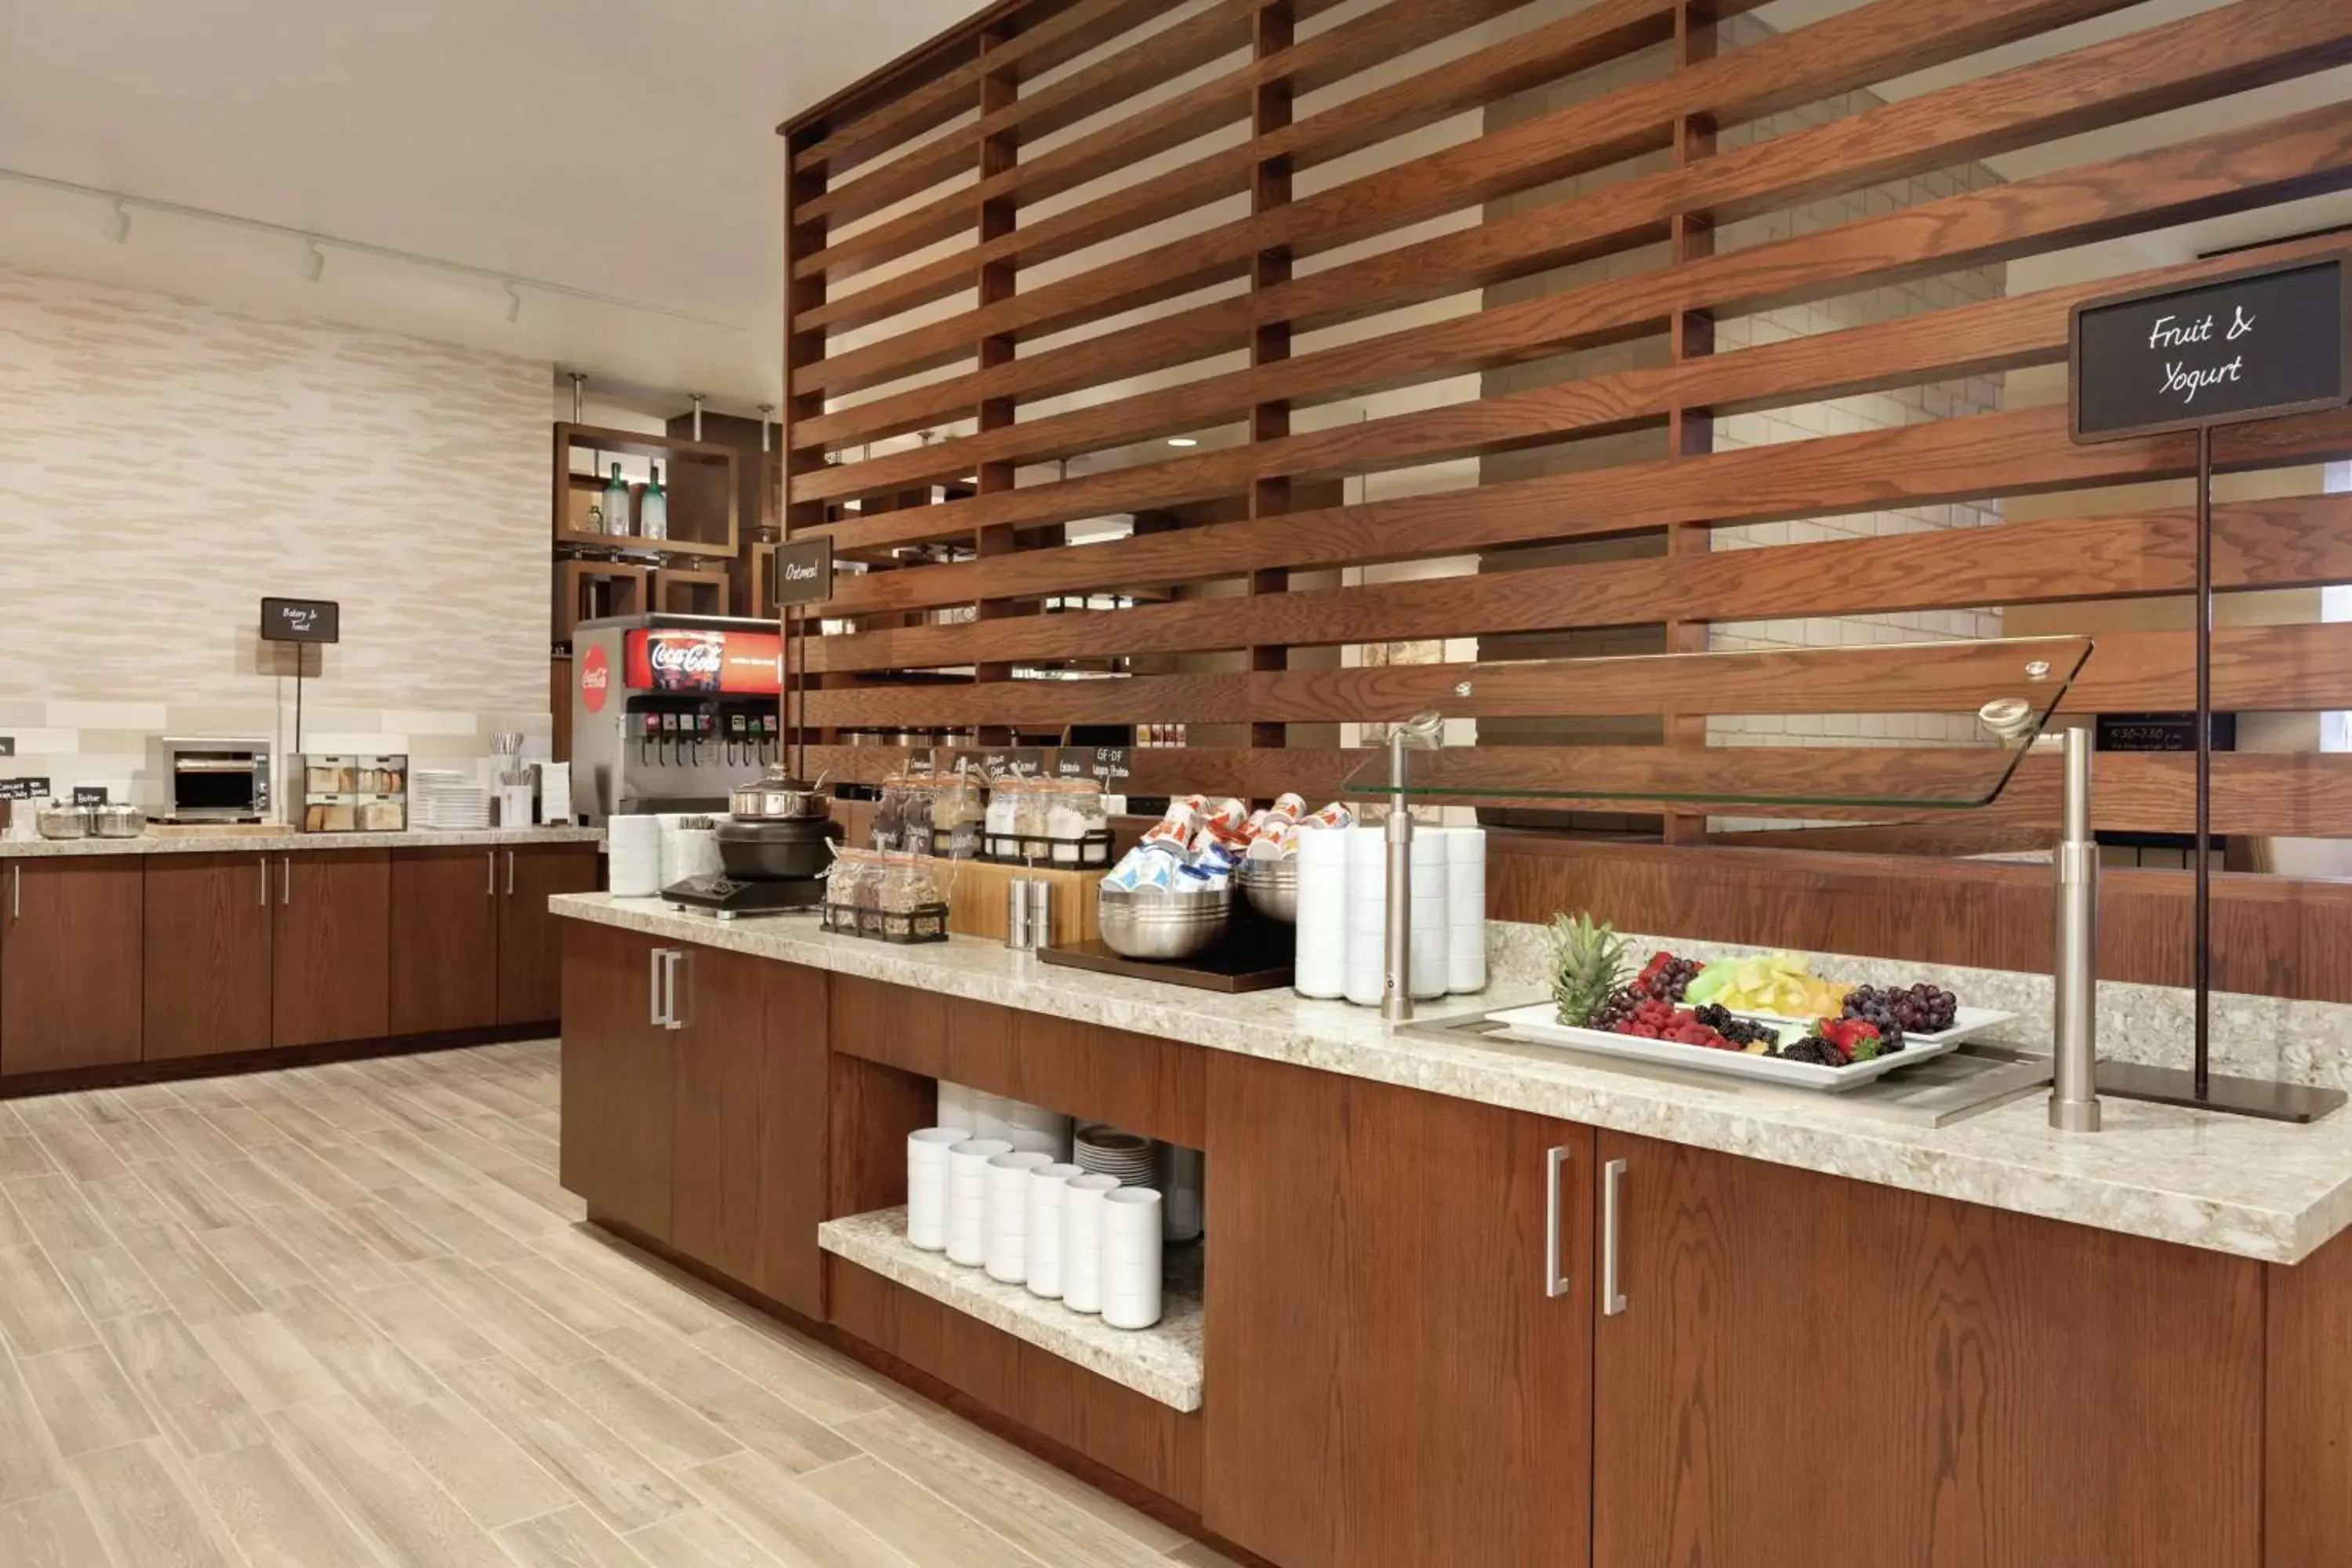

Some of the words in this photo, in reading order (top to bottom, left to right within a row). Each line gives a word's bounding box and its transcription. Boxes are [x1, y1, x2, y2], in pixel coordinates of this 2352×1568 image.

[2149, 315, 2213, 349] Fruit
[2227, 305, 2256, 340] &
[2158, 355, 2243, 404] Yogurt
[786, 557, 818, 580] Oatmeal
[282, 608, 307, 622] Bakery
[652, 642, 722, 672] Coca-Cola
[78, 793, 101, 803] Butter
